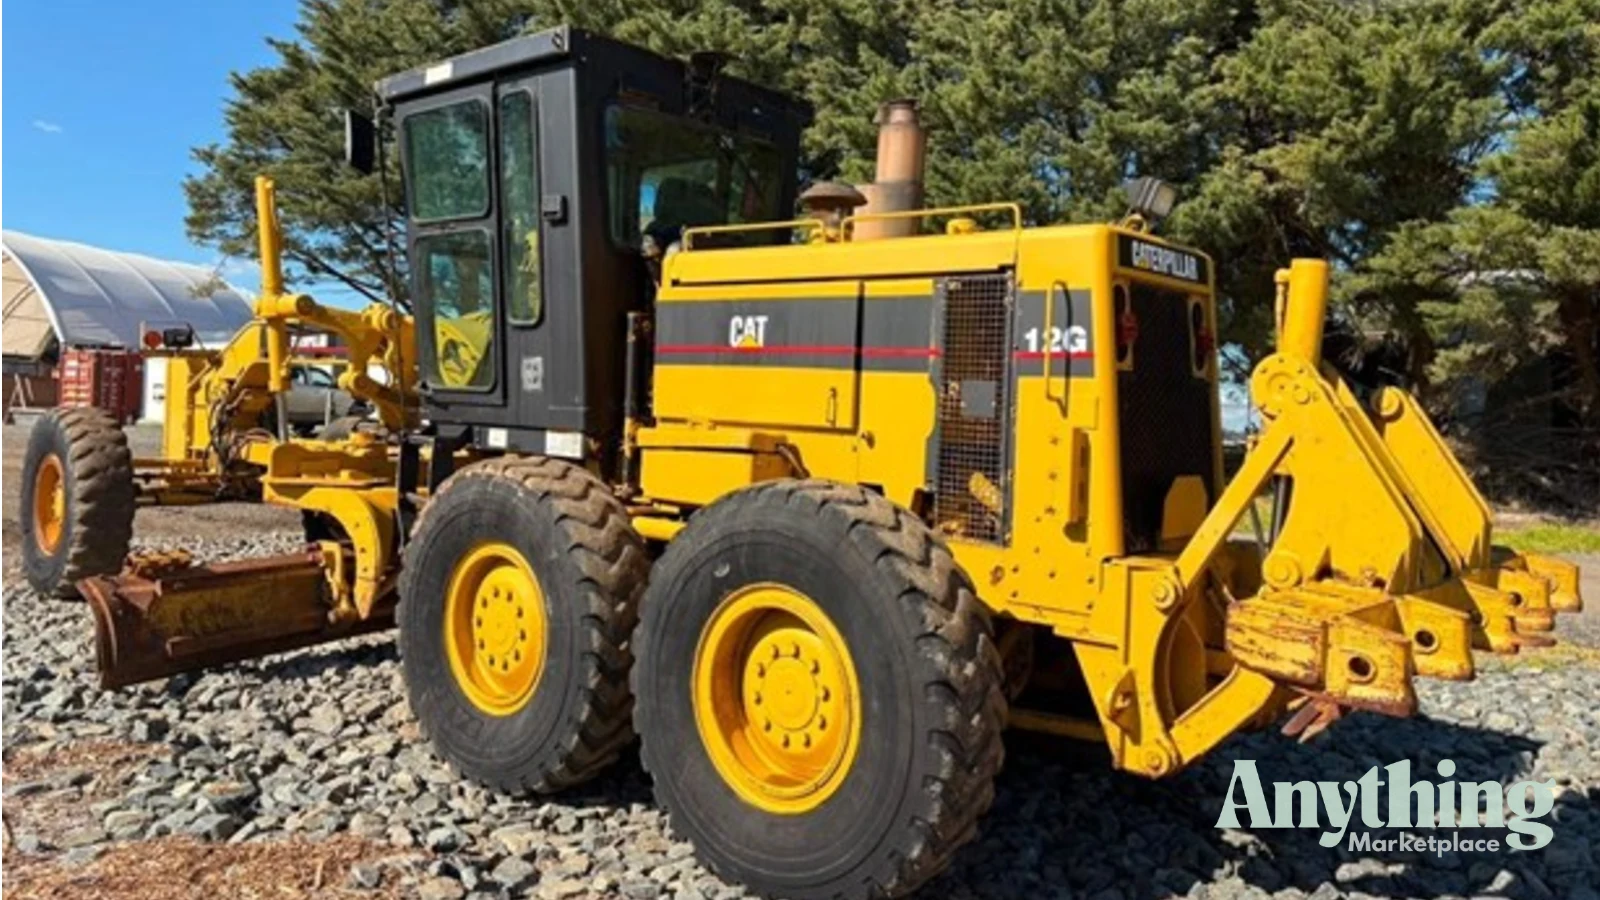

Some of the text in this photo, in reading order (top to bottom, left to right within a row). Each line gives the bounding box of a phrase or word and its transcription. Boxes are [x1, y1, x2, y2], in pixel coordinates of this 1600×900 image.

[1131, 239, 1199, 281] CATERPILLAR
[729, 315, 769, 348] CAT
[1024, 325, 1087, 353] 12G
